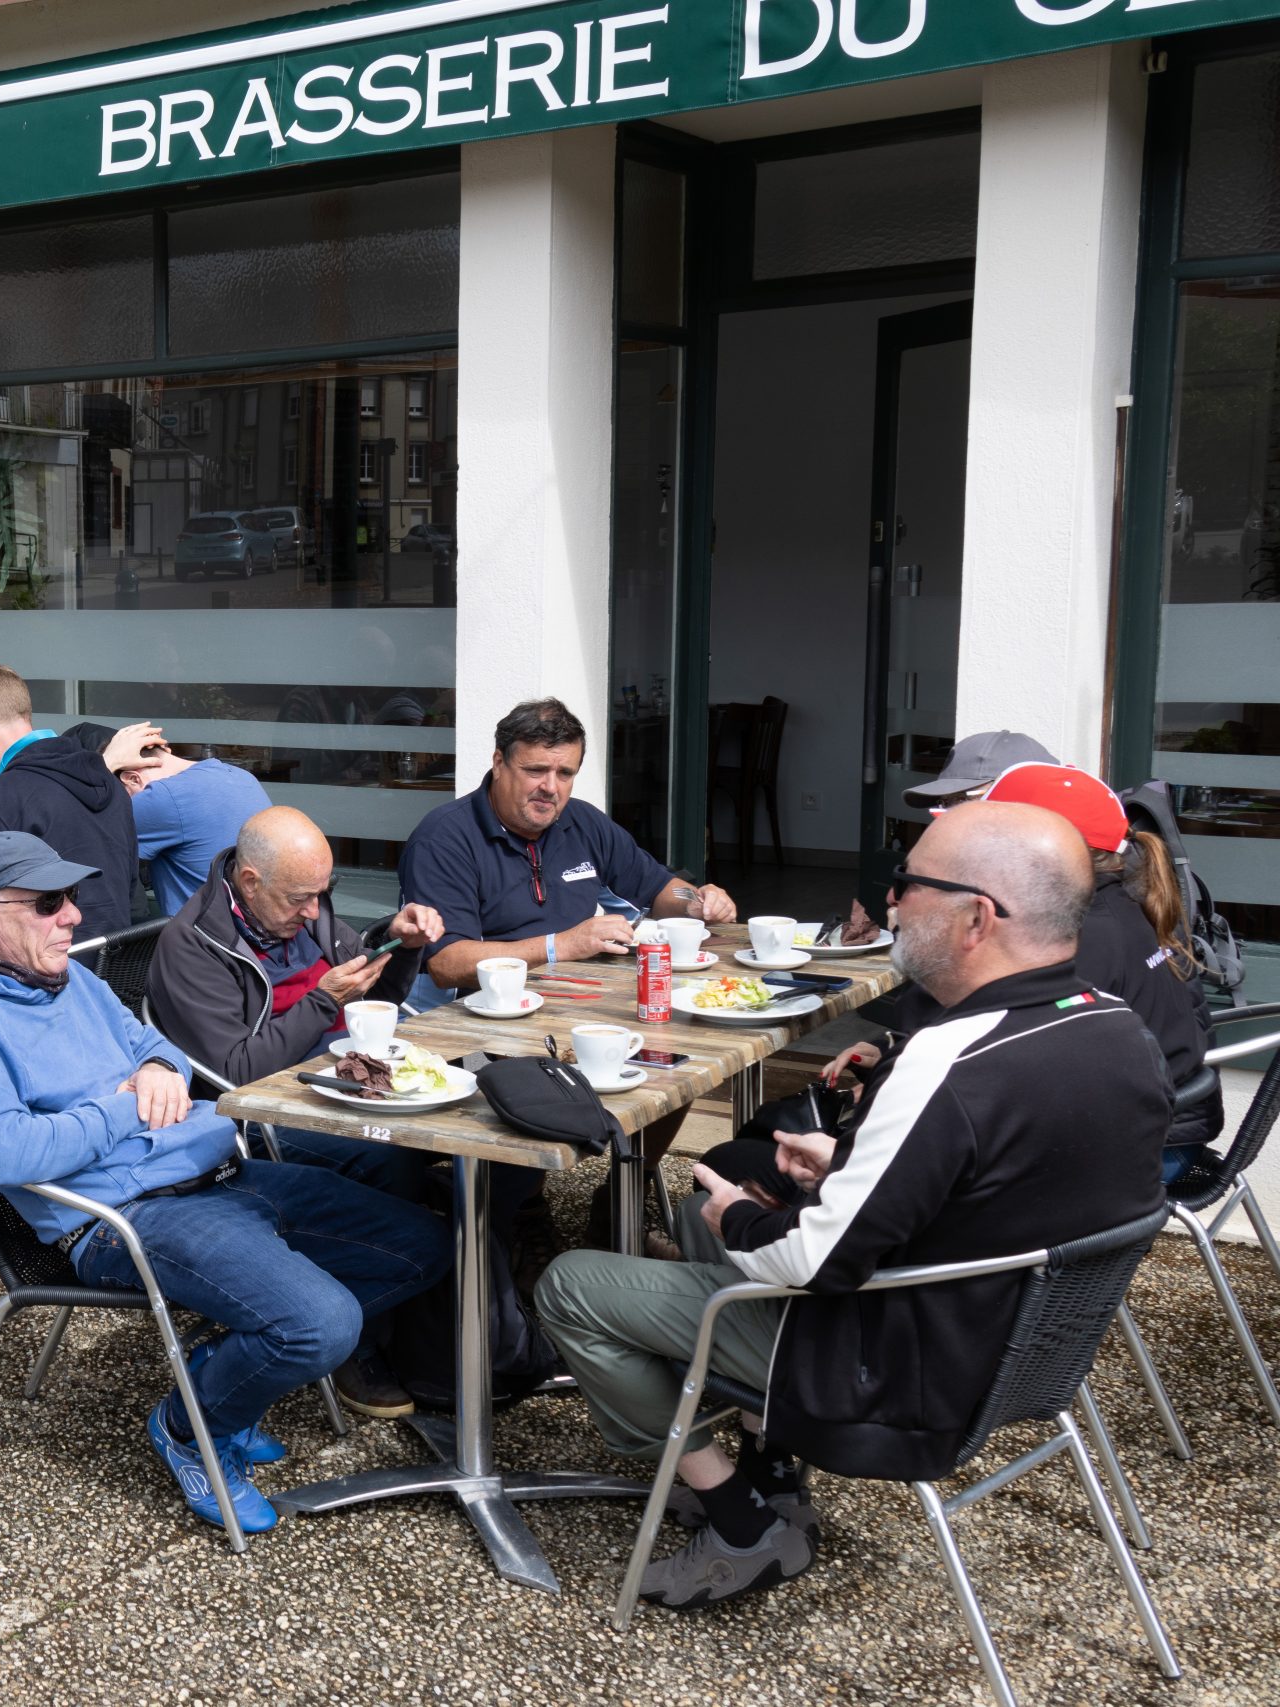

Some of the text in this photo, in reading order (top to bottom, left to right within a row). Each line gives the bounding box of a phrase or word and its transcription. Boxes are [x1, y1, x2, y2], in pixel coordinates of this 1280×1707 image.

[98, 0, 926, 176] BRASSERIE DU
[362, 1124, 391, 1141] 122
[215, 1167, 236, 1182] adidas
